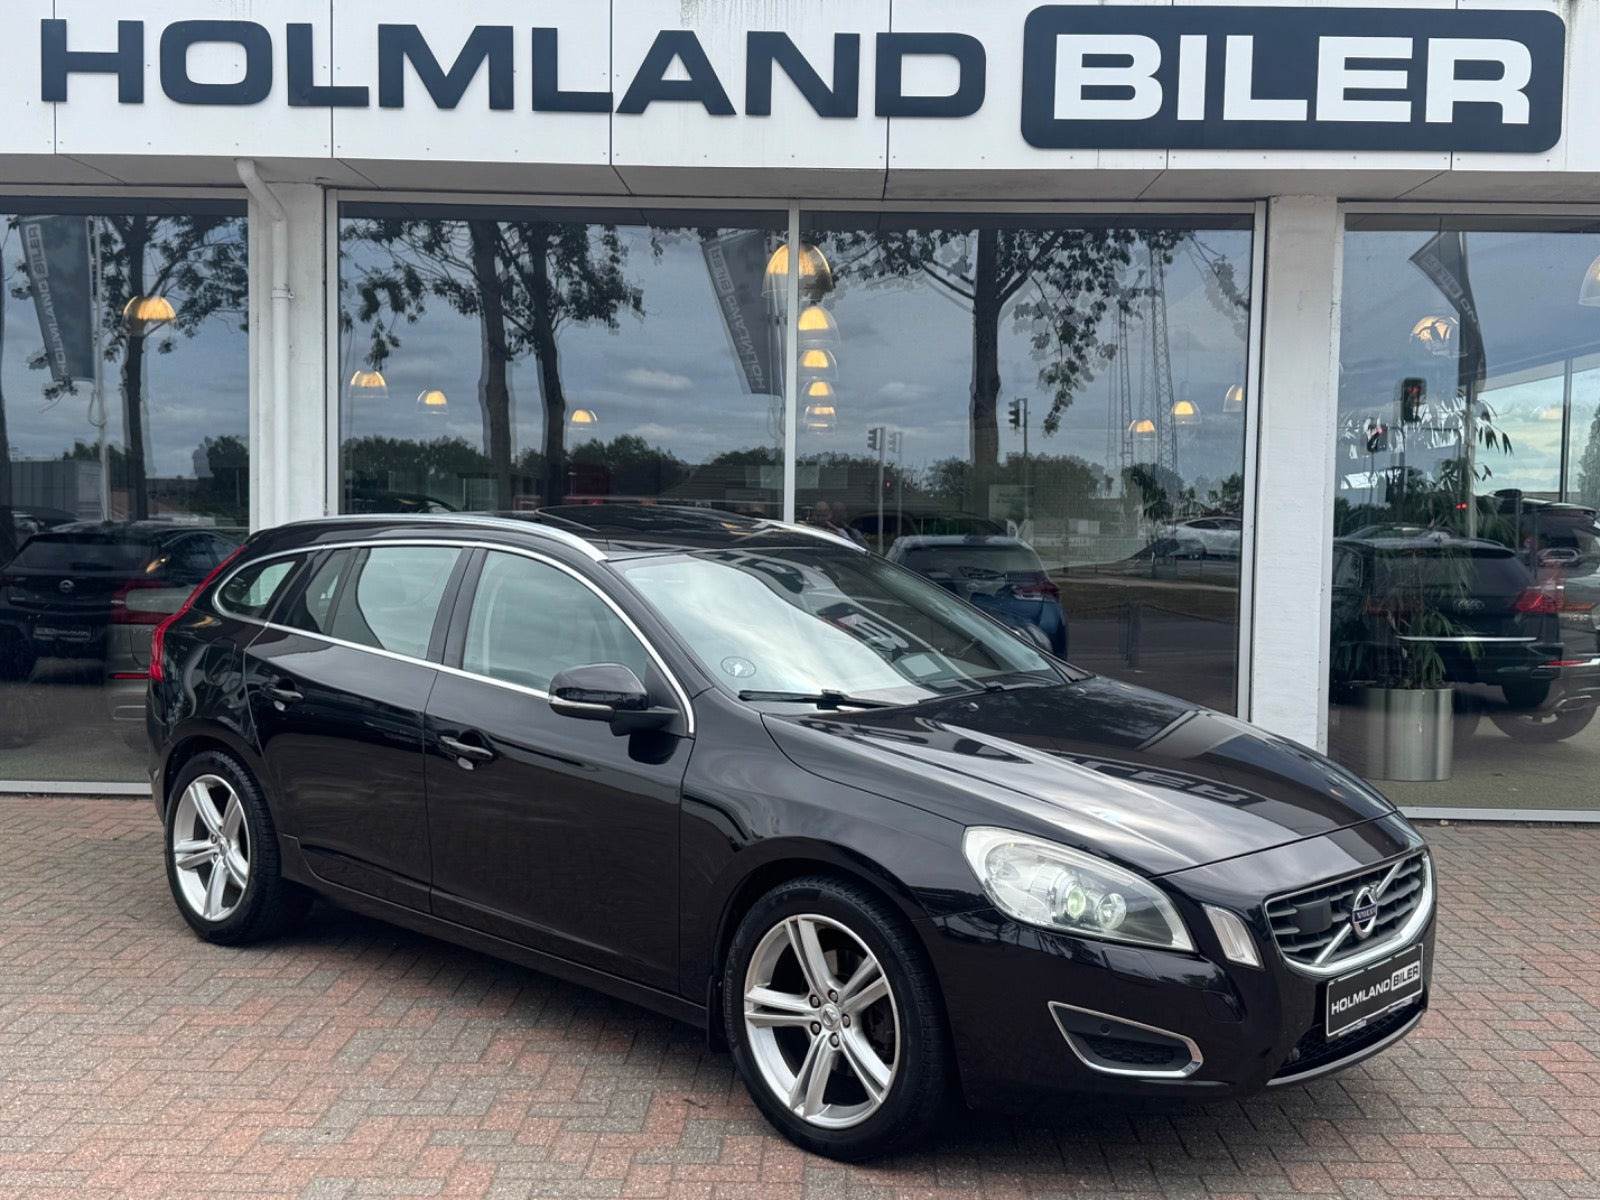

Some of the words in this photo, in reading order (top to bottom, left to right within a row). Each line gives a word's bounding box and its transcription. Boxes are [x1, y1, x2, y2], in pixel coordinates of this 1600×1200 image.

[40, 18, 987, 119] HOLMLAND
[1053, 33, 1532, 126] BILER
[1331, 979, 1390, 1015] HOLMLAND
[1393, 964, 1420, 987] BILER
